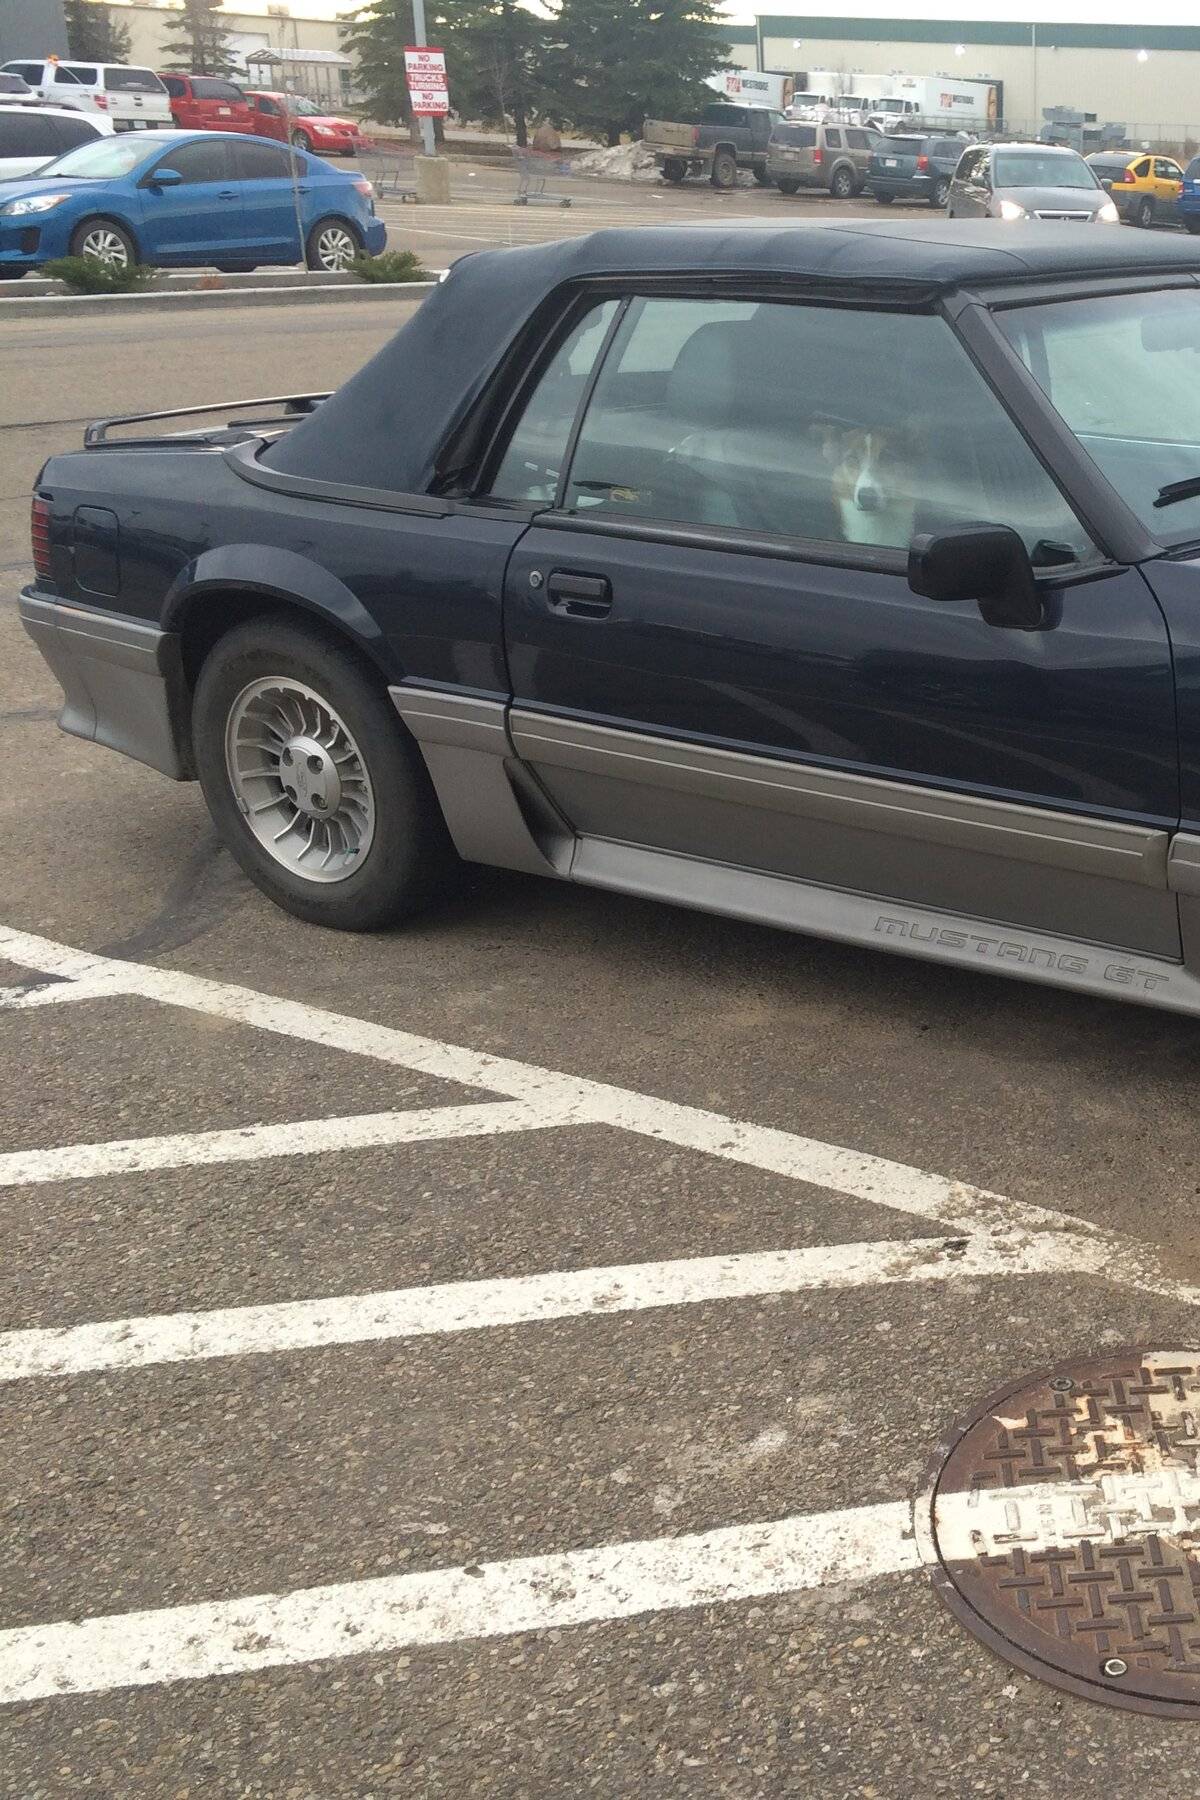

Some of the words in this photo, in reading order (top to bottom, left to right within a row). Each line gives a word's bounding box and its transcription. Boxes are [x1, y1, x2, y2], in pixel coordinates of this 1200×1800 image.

[417, 54, 430, 62] NO
[407, 62, 443, 71] PARKING
[410, 73, 444, 82] TRUCKS
[409, 82, 447, 90] TURNING
[422, 92, 434, 100] NO
[413, 101, 447, 110] PARKING
[874, 915, 1090, 975] MUSTANG
[1103, 963, 1170, 991] GT
